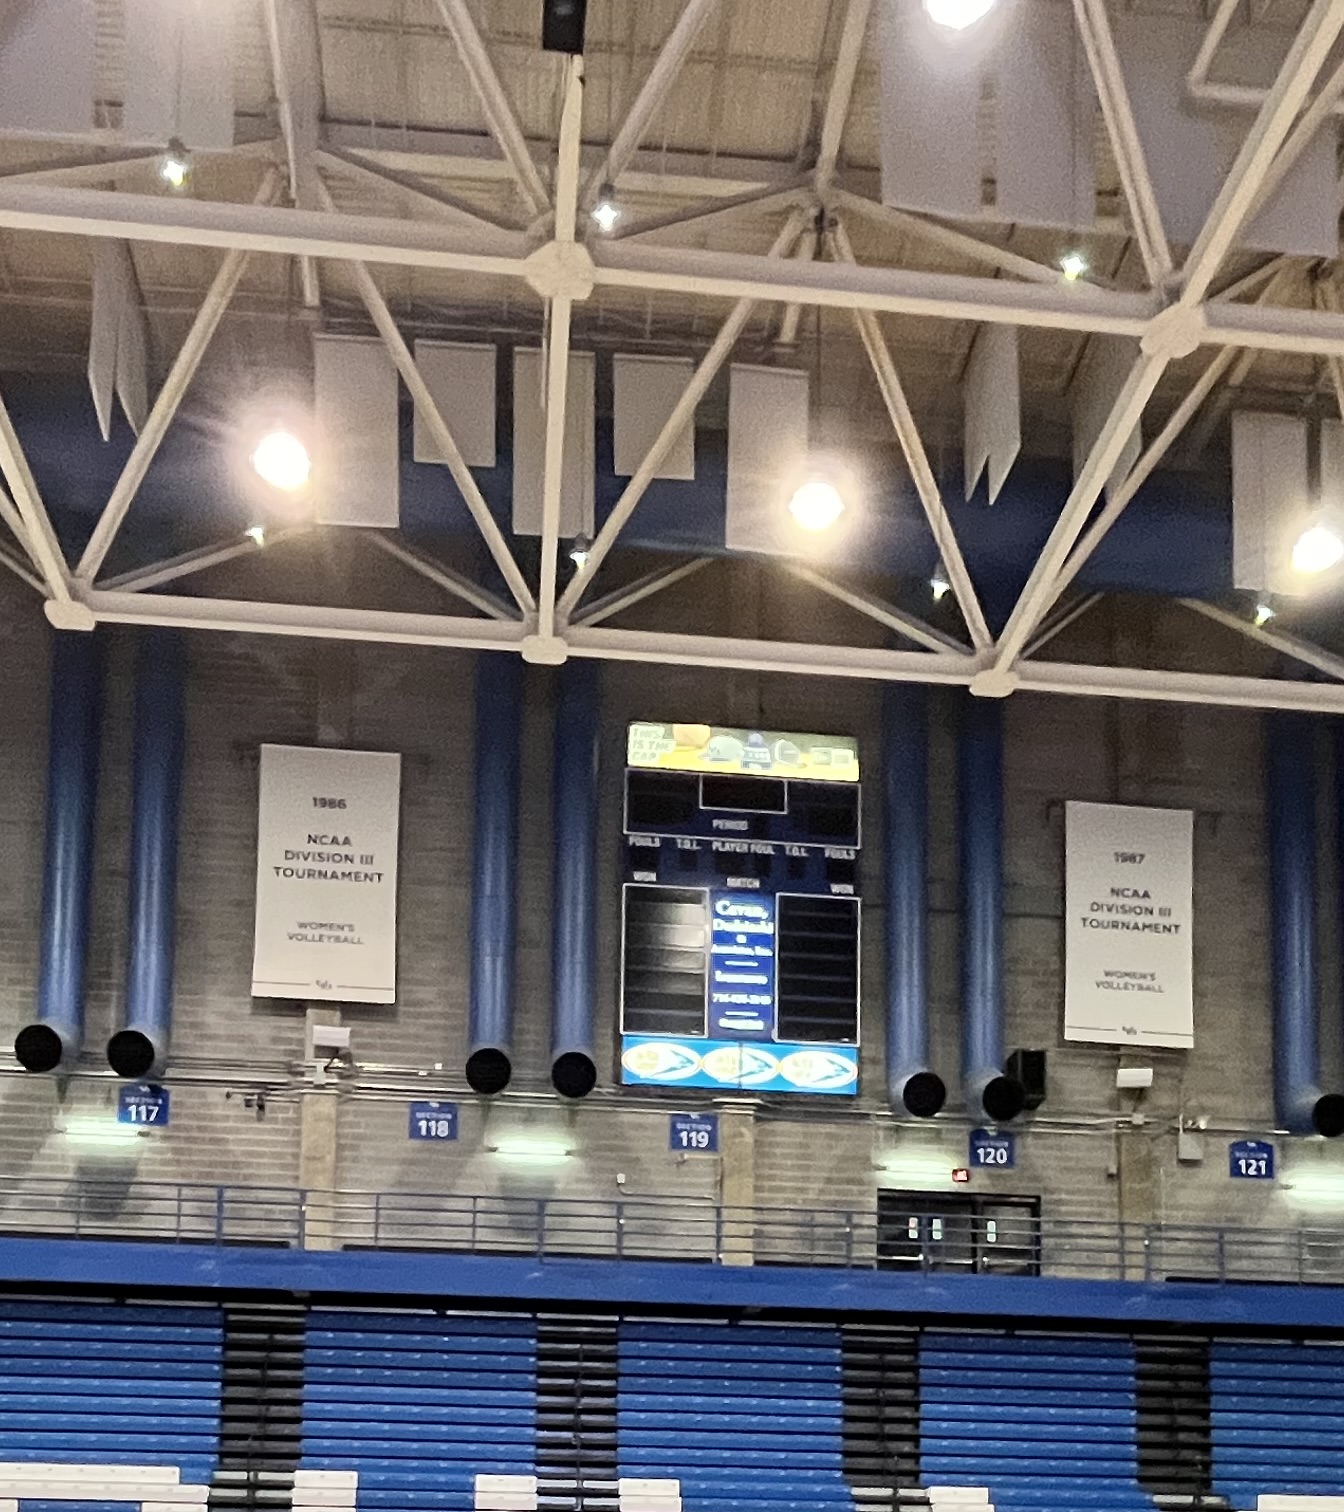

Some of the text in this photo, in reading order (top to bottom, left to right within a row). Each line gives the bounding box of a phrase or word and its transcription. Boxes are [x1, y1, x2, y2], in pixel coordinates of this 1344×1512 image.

[312, 796, 347, 809] 1986
[306, 833, 353, 847] NCAA
[712, 840, 749, 853] PLAYER
[750, 842, 775, 855] FOUL
[284, 850, 374, 866] DIVISION III
[273, 866, 384, 884] TOURNAMENT
[1110, 887, 1151, 900] NCAA
[1090, 902, 1171, 917] DIVISION III
[297, 922, 355, 932] WOMEN'S
[1081, 917, 1181, 934] TOURNAMENT
[287, 932, 365, 945] VOLLEYBALL
[1103, 970, 1156, 981] WOMEN'S
[1095, 981, 1165, 993] VOLLEYBALL
[127, 1104, 159, 1122] 117
[418, 1120, 449, 1137] 118
[680, 1130, 709, 1148] 119
[976, 1147, 1008, 1164] 120
[1238, 1159, 1266, 1175] 121
